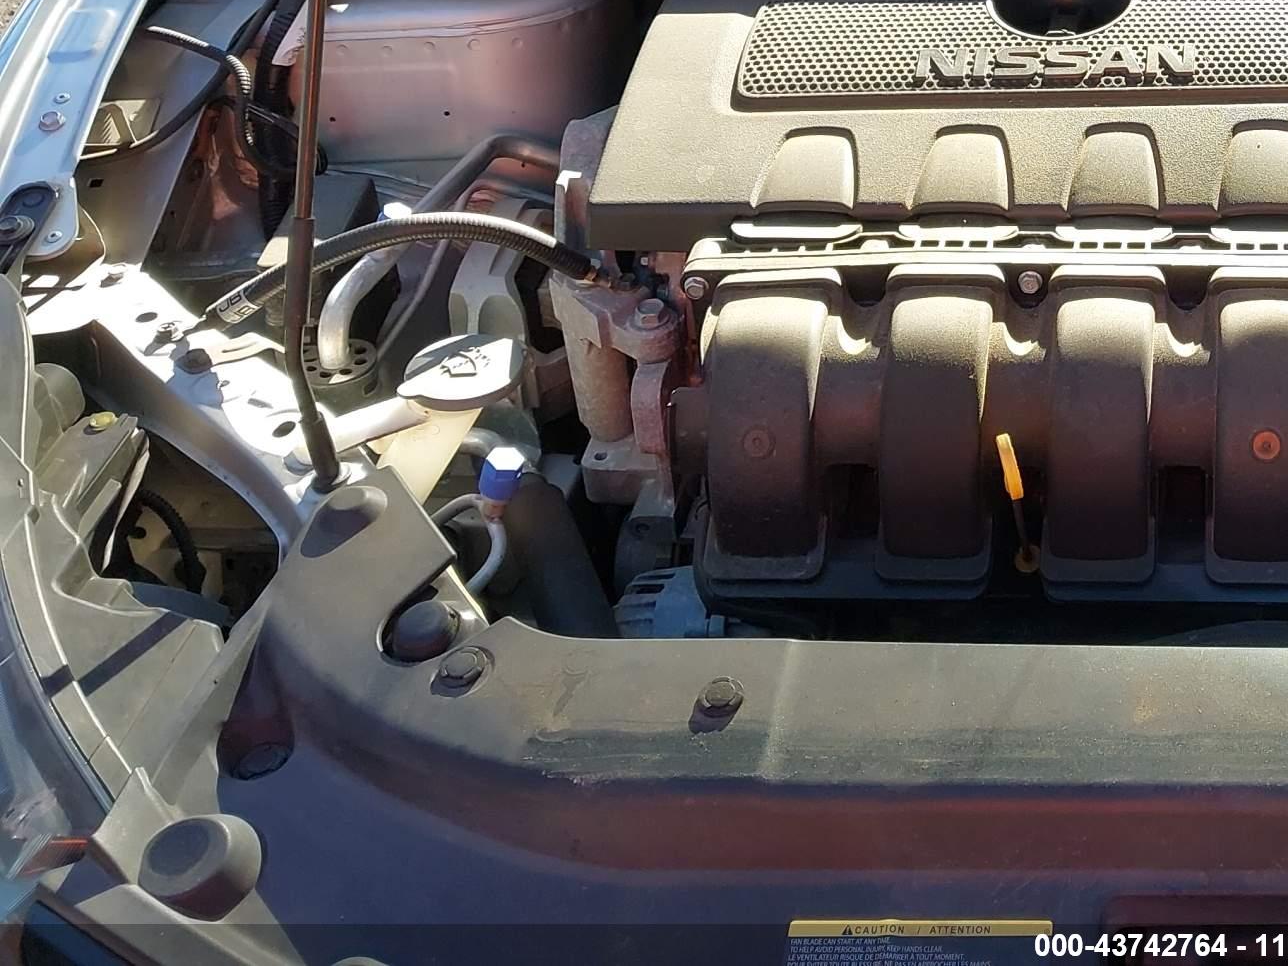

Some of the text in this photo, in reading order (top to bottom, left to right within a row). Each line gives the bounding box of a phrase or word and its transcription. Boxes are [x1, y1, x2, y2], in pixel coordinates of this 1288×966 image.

[915, 43, 1196, 86] NISSAN
[218, 290, 243, 313] JB
[854, 924, 905, 935] CAUTION
[928, 926, 992, 935] ATTENTION
